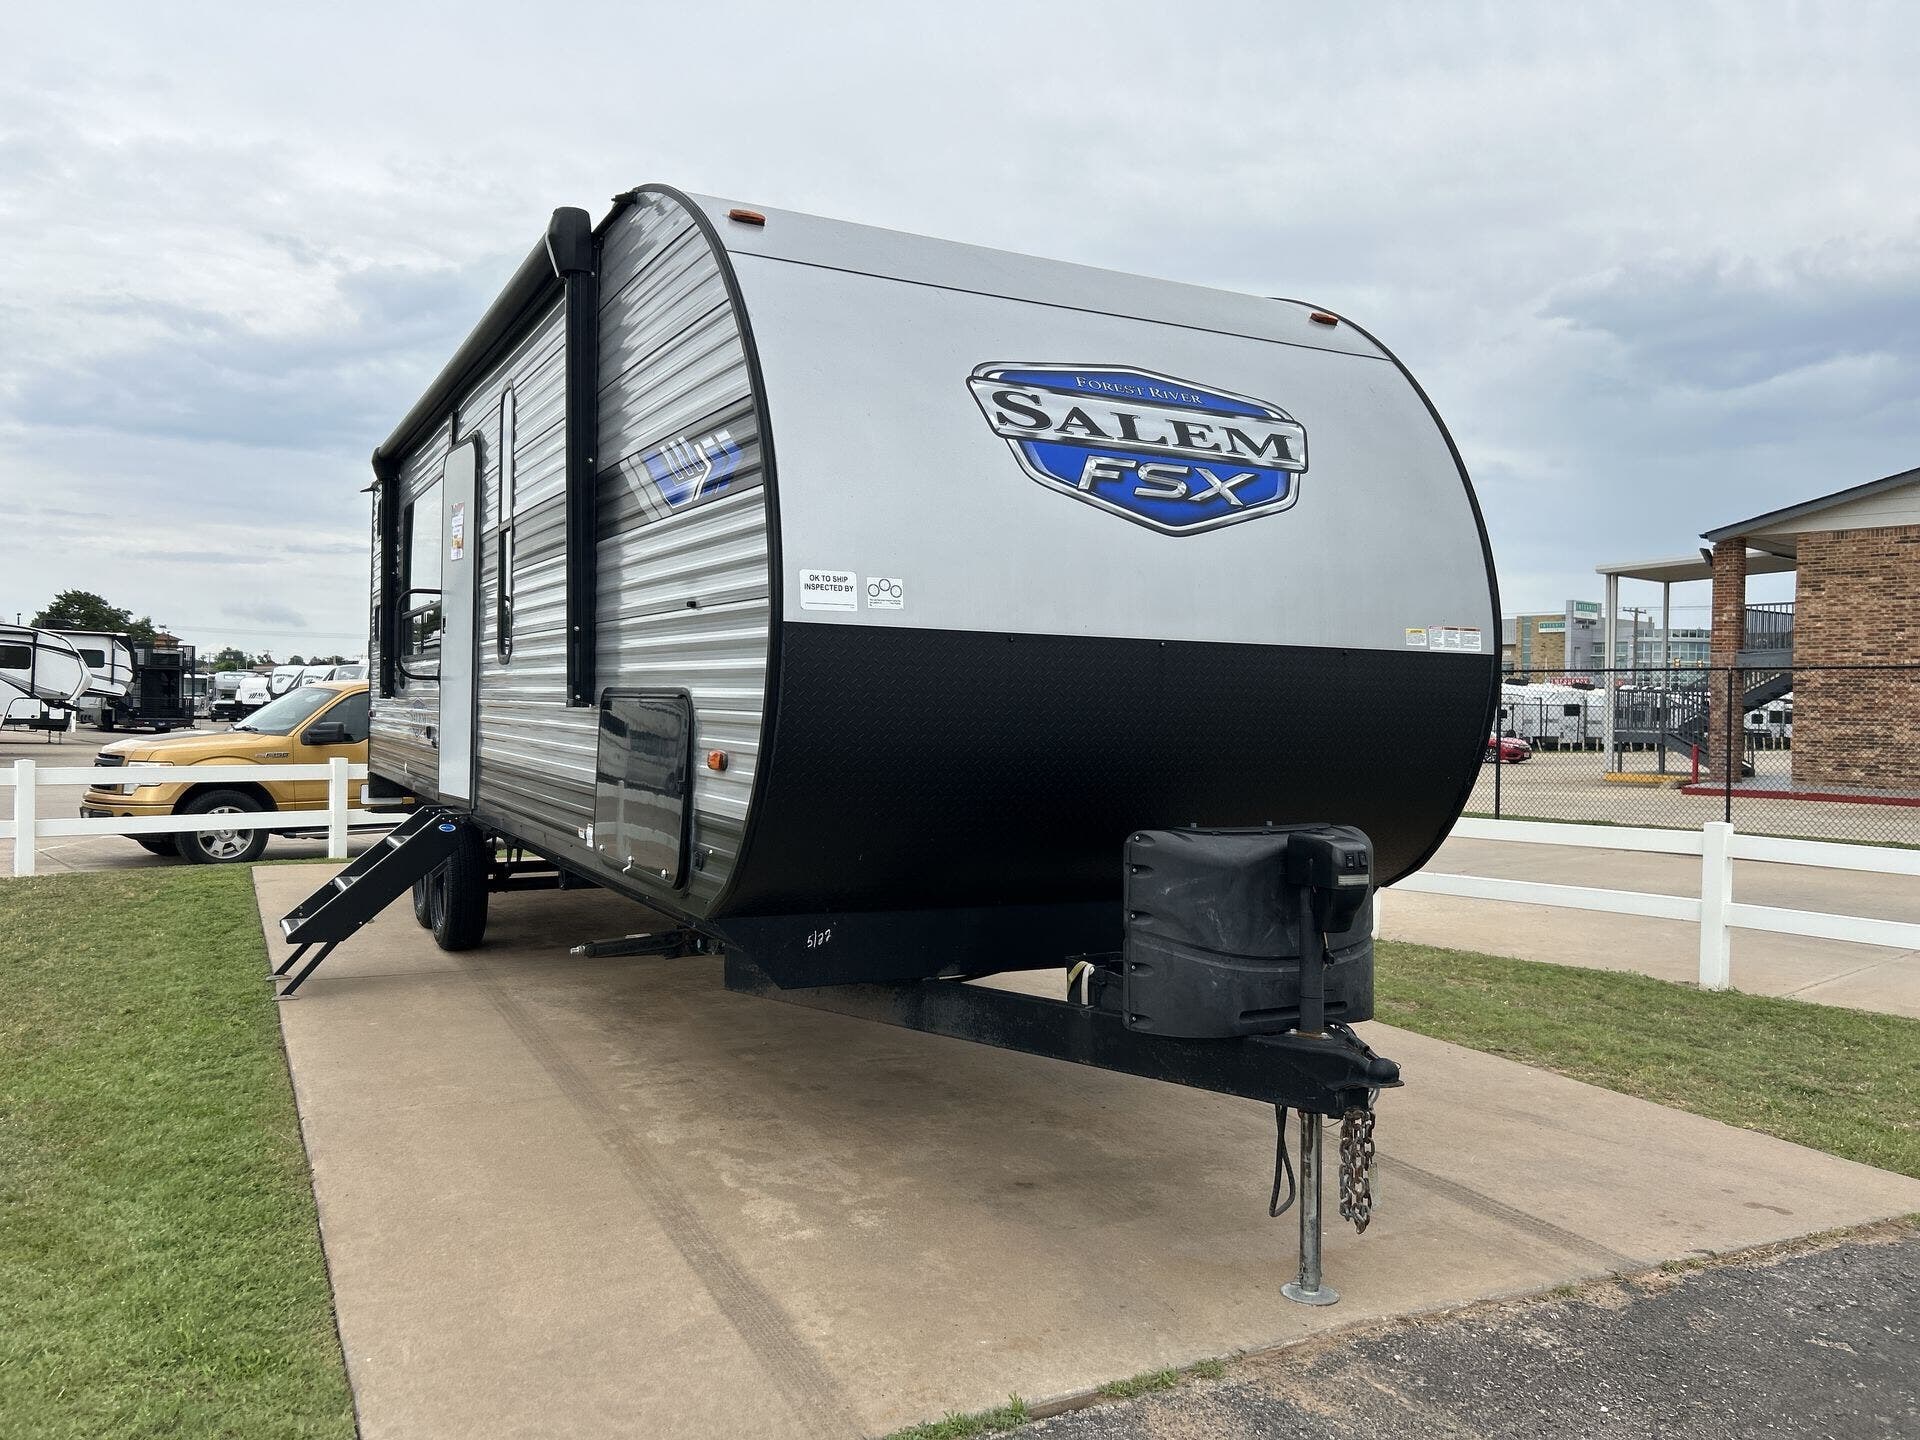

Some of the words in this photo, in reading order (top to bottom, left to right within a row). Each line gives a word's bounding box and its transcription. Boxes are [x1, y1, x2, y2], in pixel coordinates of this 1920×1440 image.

[1075, 375, 1145, 397] FOREST
[1149, 386, 1203, 406] RIVER
[991, 390, 1300, 463] SALEM
[1077, 454, 1256, 508] FSX
[804, 583, 843, 592] INSPECTED
[844, 584, 854, 593] BY
[809, 574, 821, 582] OK
[821, 574, 831, 583] TO
[832, 575, 849, 583] SHIP
